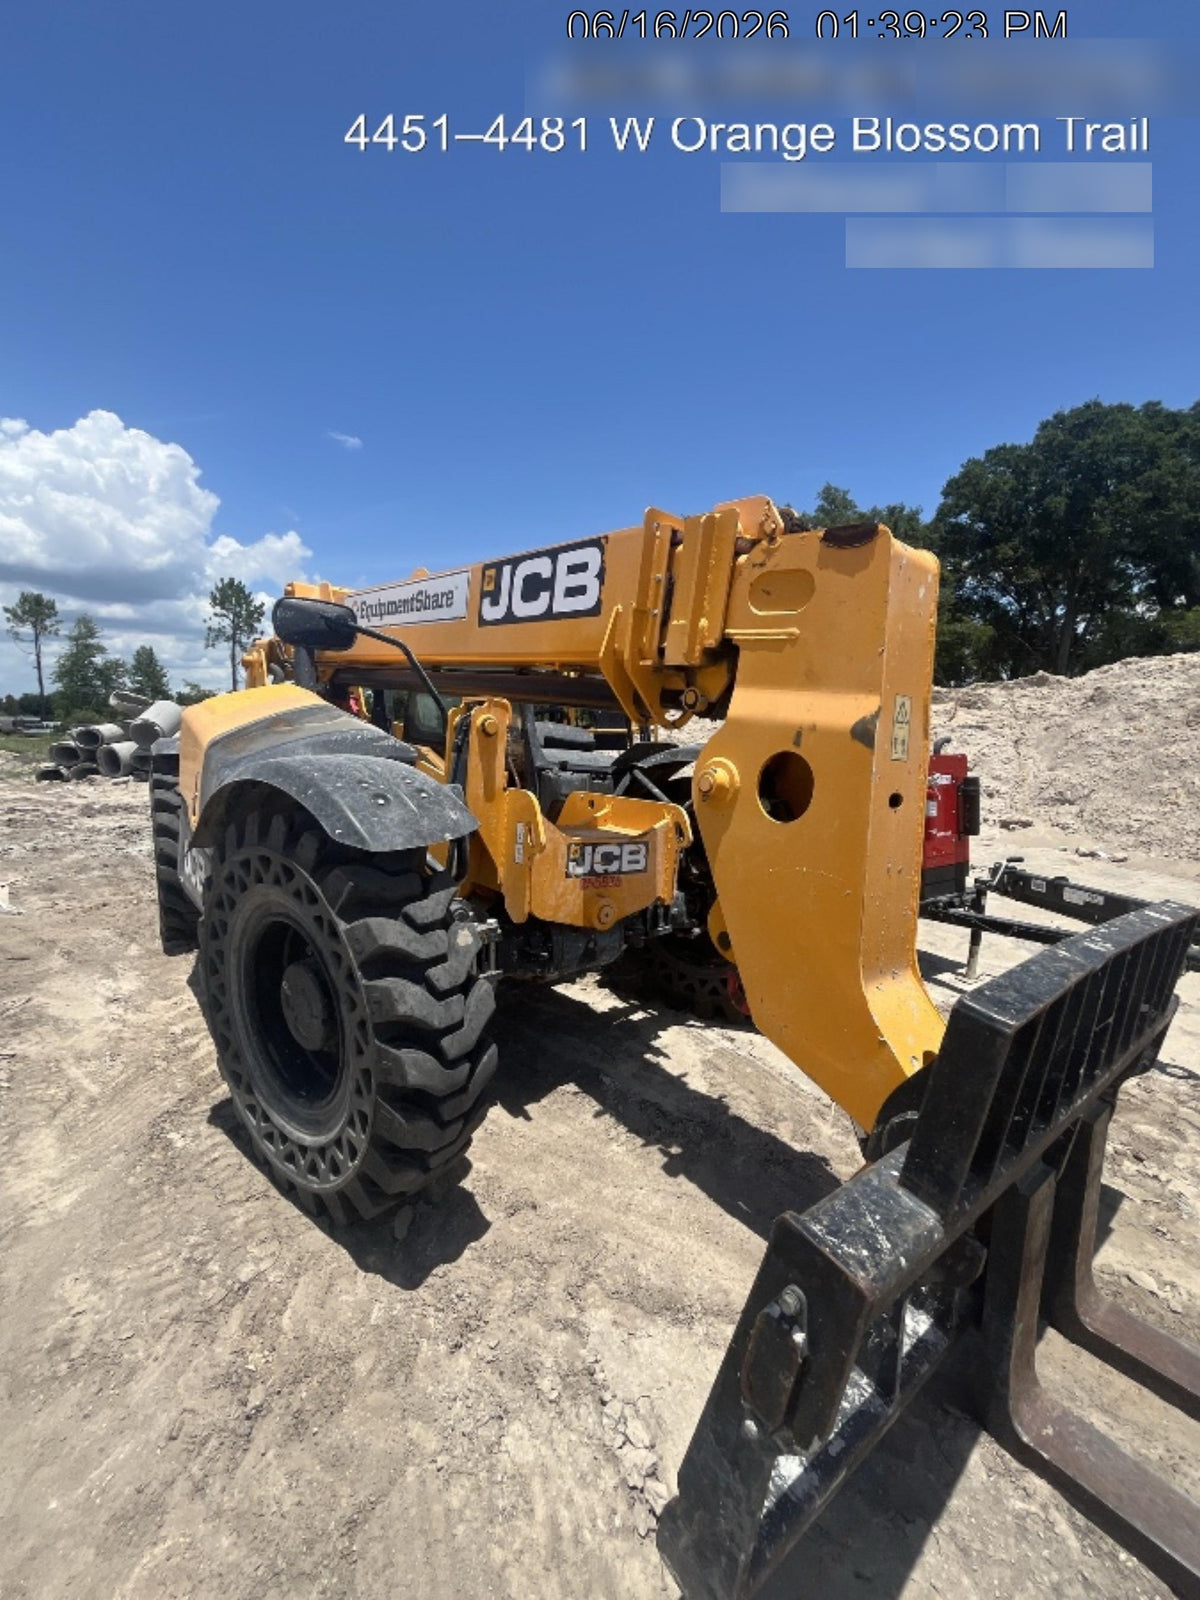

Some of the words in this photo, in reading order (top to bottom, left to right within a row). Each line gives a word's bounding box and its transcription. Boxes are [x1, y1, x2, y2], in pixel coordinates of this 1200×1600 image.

[481, 546, 602, 621] JCB
[360, 589, 454, 622] EquipmentShare
[568, 844, 647, 875] JCB
